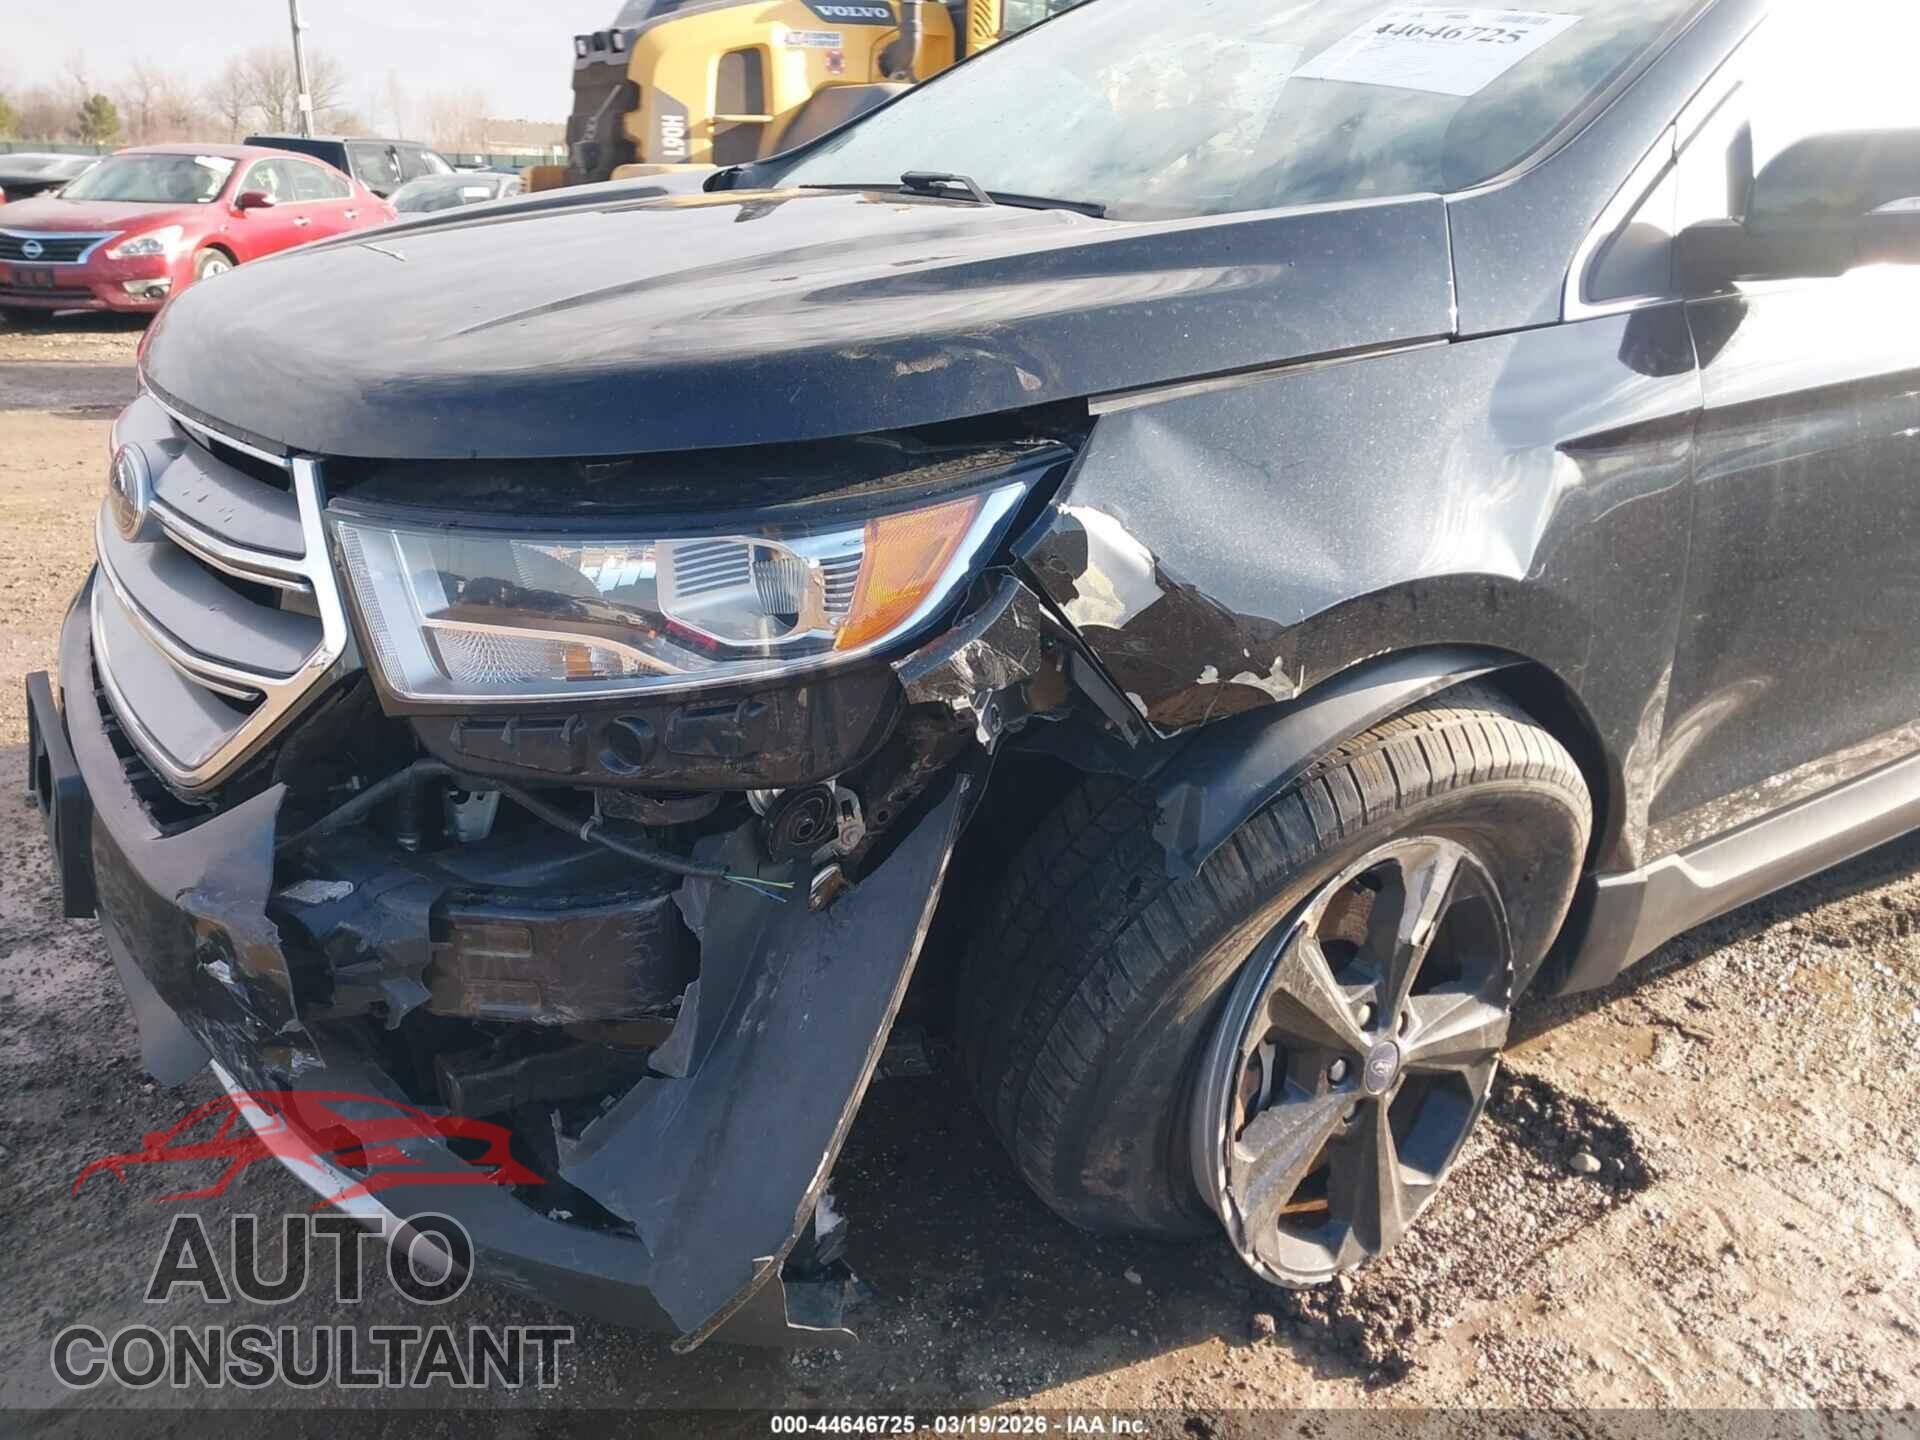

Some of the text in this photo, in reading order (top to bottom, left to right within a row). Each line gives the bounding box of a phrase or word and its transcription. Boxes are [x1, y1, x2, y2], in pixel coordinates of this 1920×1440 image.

[815, 5, 890, 18] VOLVO
[1375, 23, 1529, 44] 44646725
[660, 114, 685, 156] L90H
